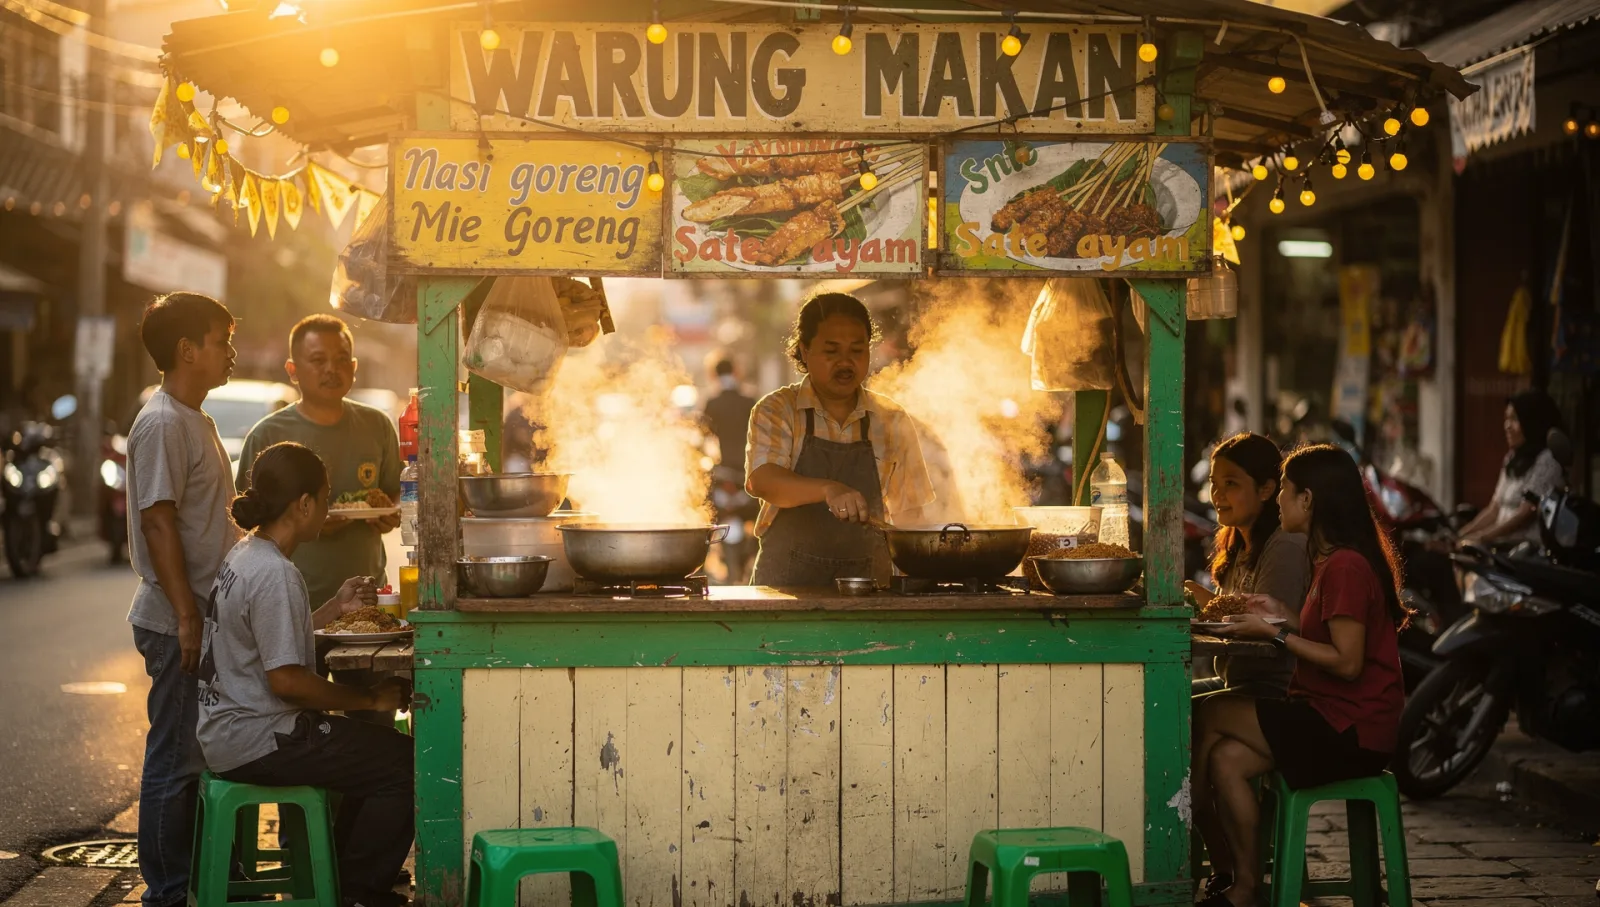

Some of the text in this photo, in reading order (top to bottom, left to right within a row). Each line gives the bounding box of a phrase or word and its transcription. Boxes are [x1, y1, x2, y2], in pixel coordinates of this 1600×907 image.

[459, 31, 1137, 122] WARUNG MAKAN
[404, 147, 645, 211] Nasi goreng
[410, 201, 641, 260] Mie Goreng
[674, 225, 917, 273] Sate ayam
[955, 219, 1189, 271] Sate ayam
